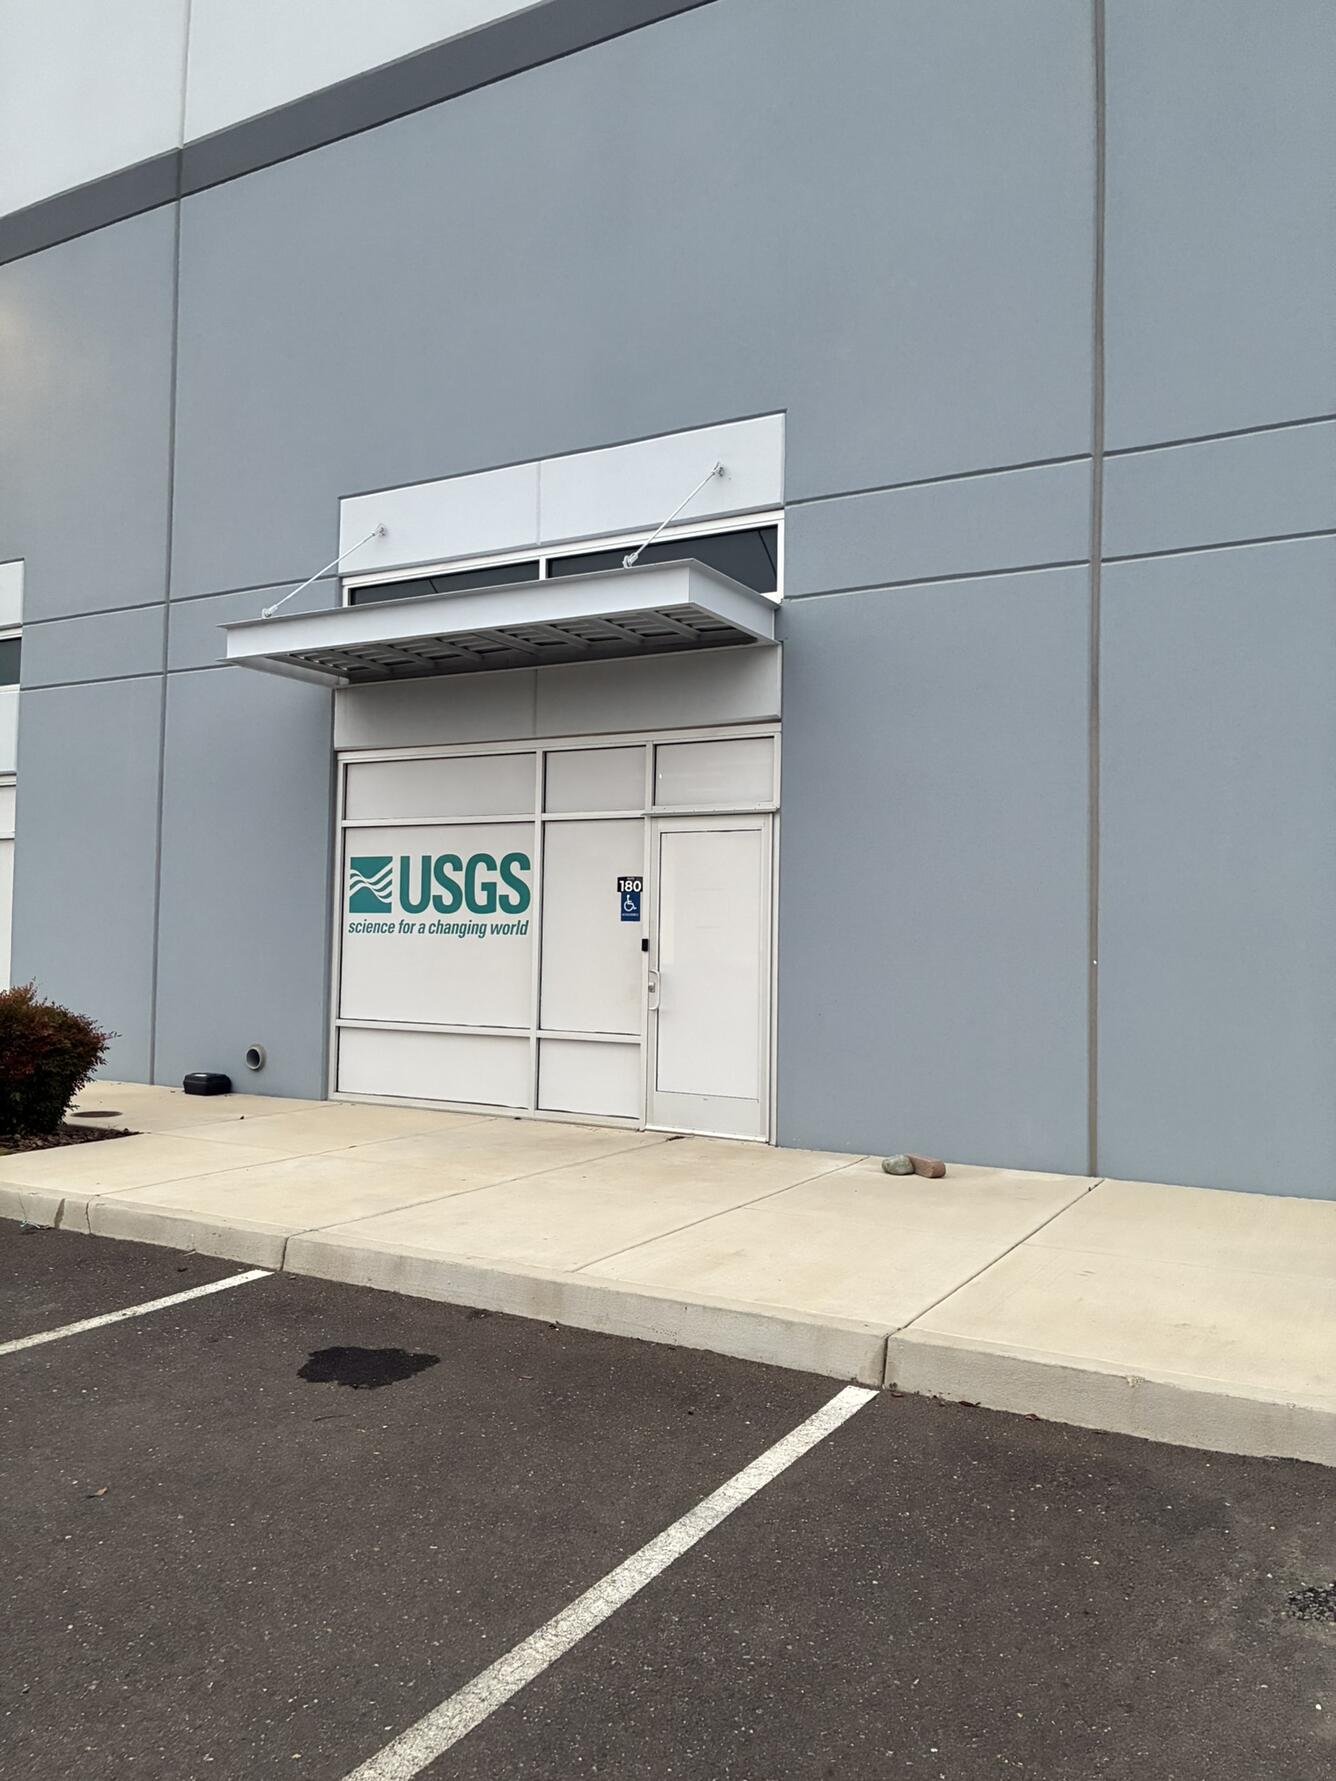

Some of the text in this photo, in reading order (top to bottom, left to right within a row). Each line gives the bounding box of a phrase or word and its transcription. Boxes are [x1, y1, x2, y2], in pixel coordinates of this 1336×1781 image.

[399, 852, 531, 914] USGS
[619, 880, 642, 892] 180
[348, 919, 529, 939] science for a changing world
